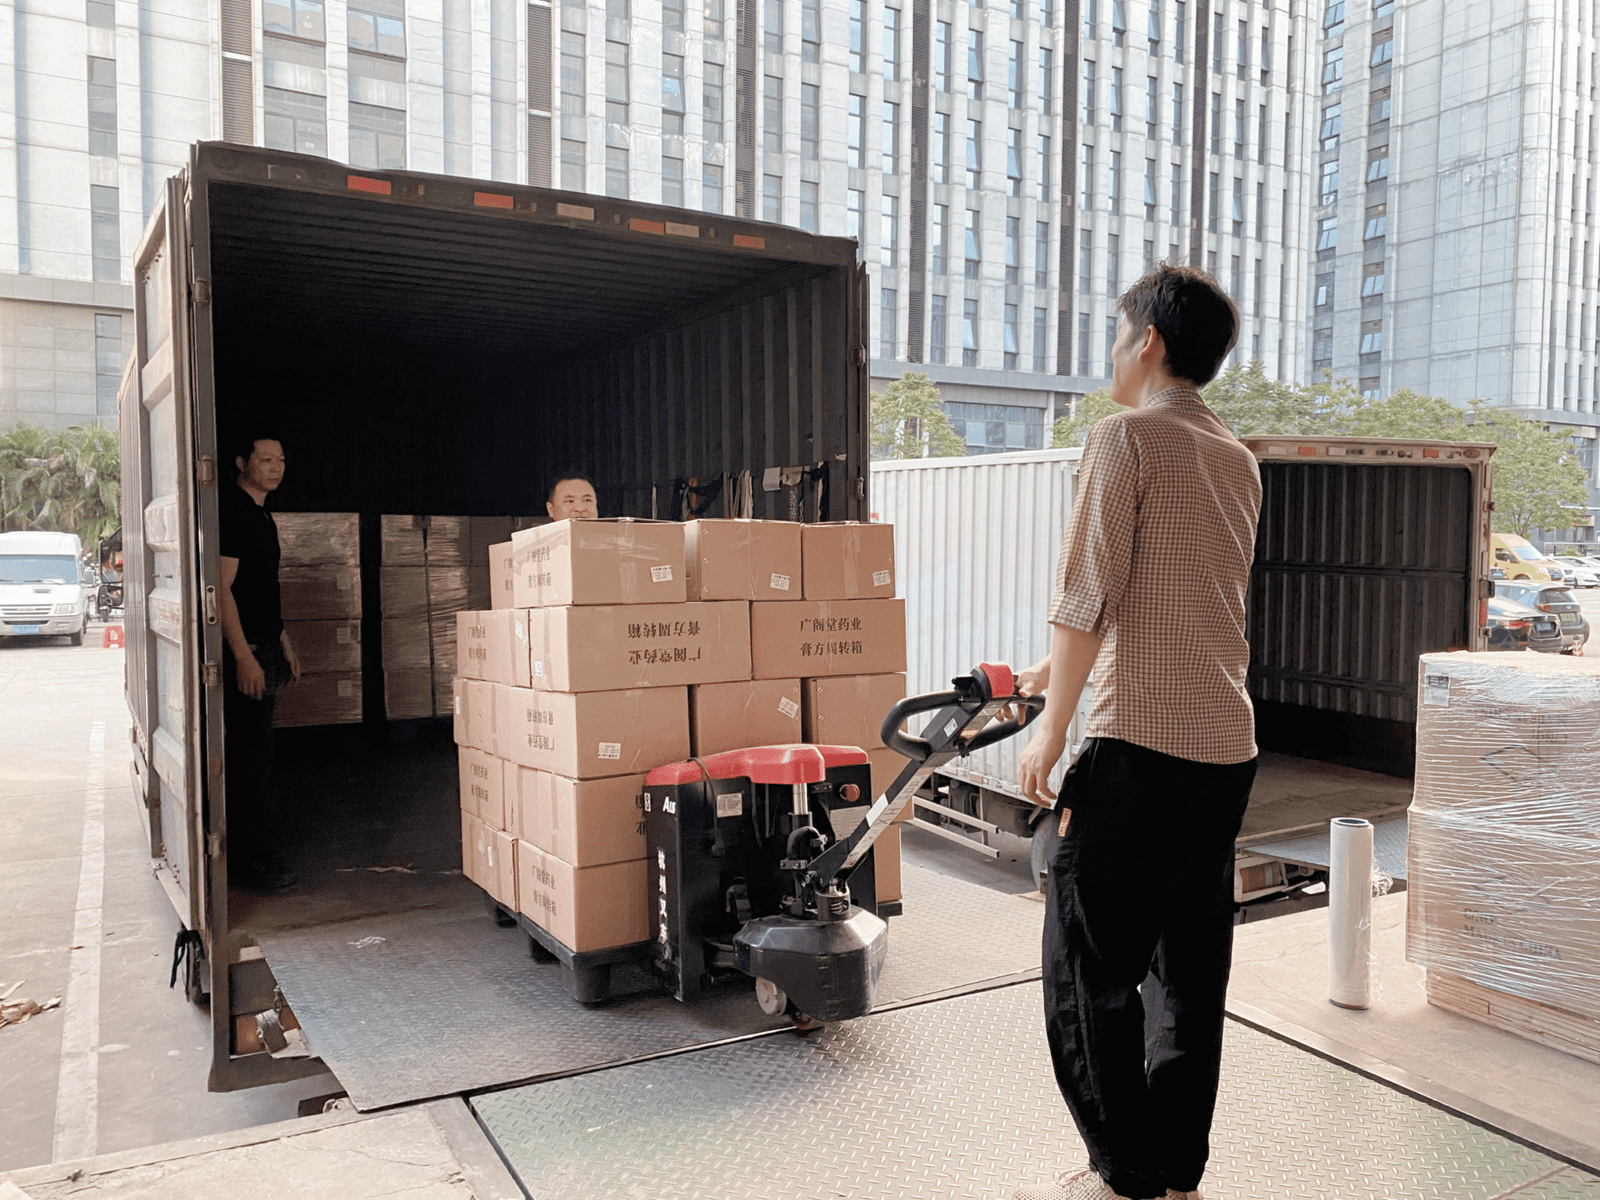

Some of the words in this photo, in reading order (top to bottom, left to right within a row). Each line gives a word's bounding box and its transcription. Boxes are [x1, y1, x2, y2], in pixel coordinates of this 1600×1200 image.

[628, 620, 701, 639] 膏方周转箱
[799, 617, 862, 633] 广阁堂药业
[628, 646, 701, 665] 广阁堂药业
[800, 640, 862, 657] 膏方周转箱
